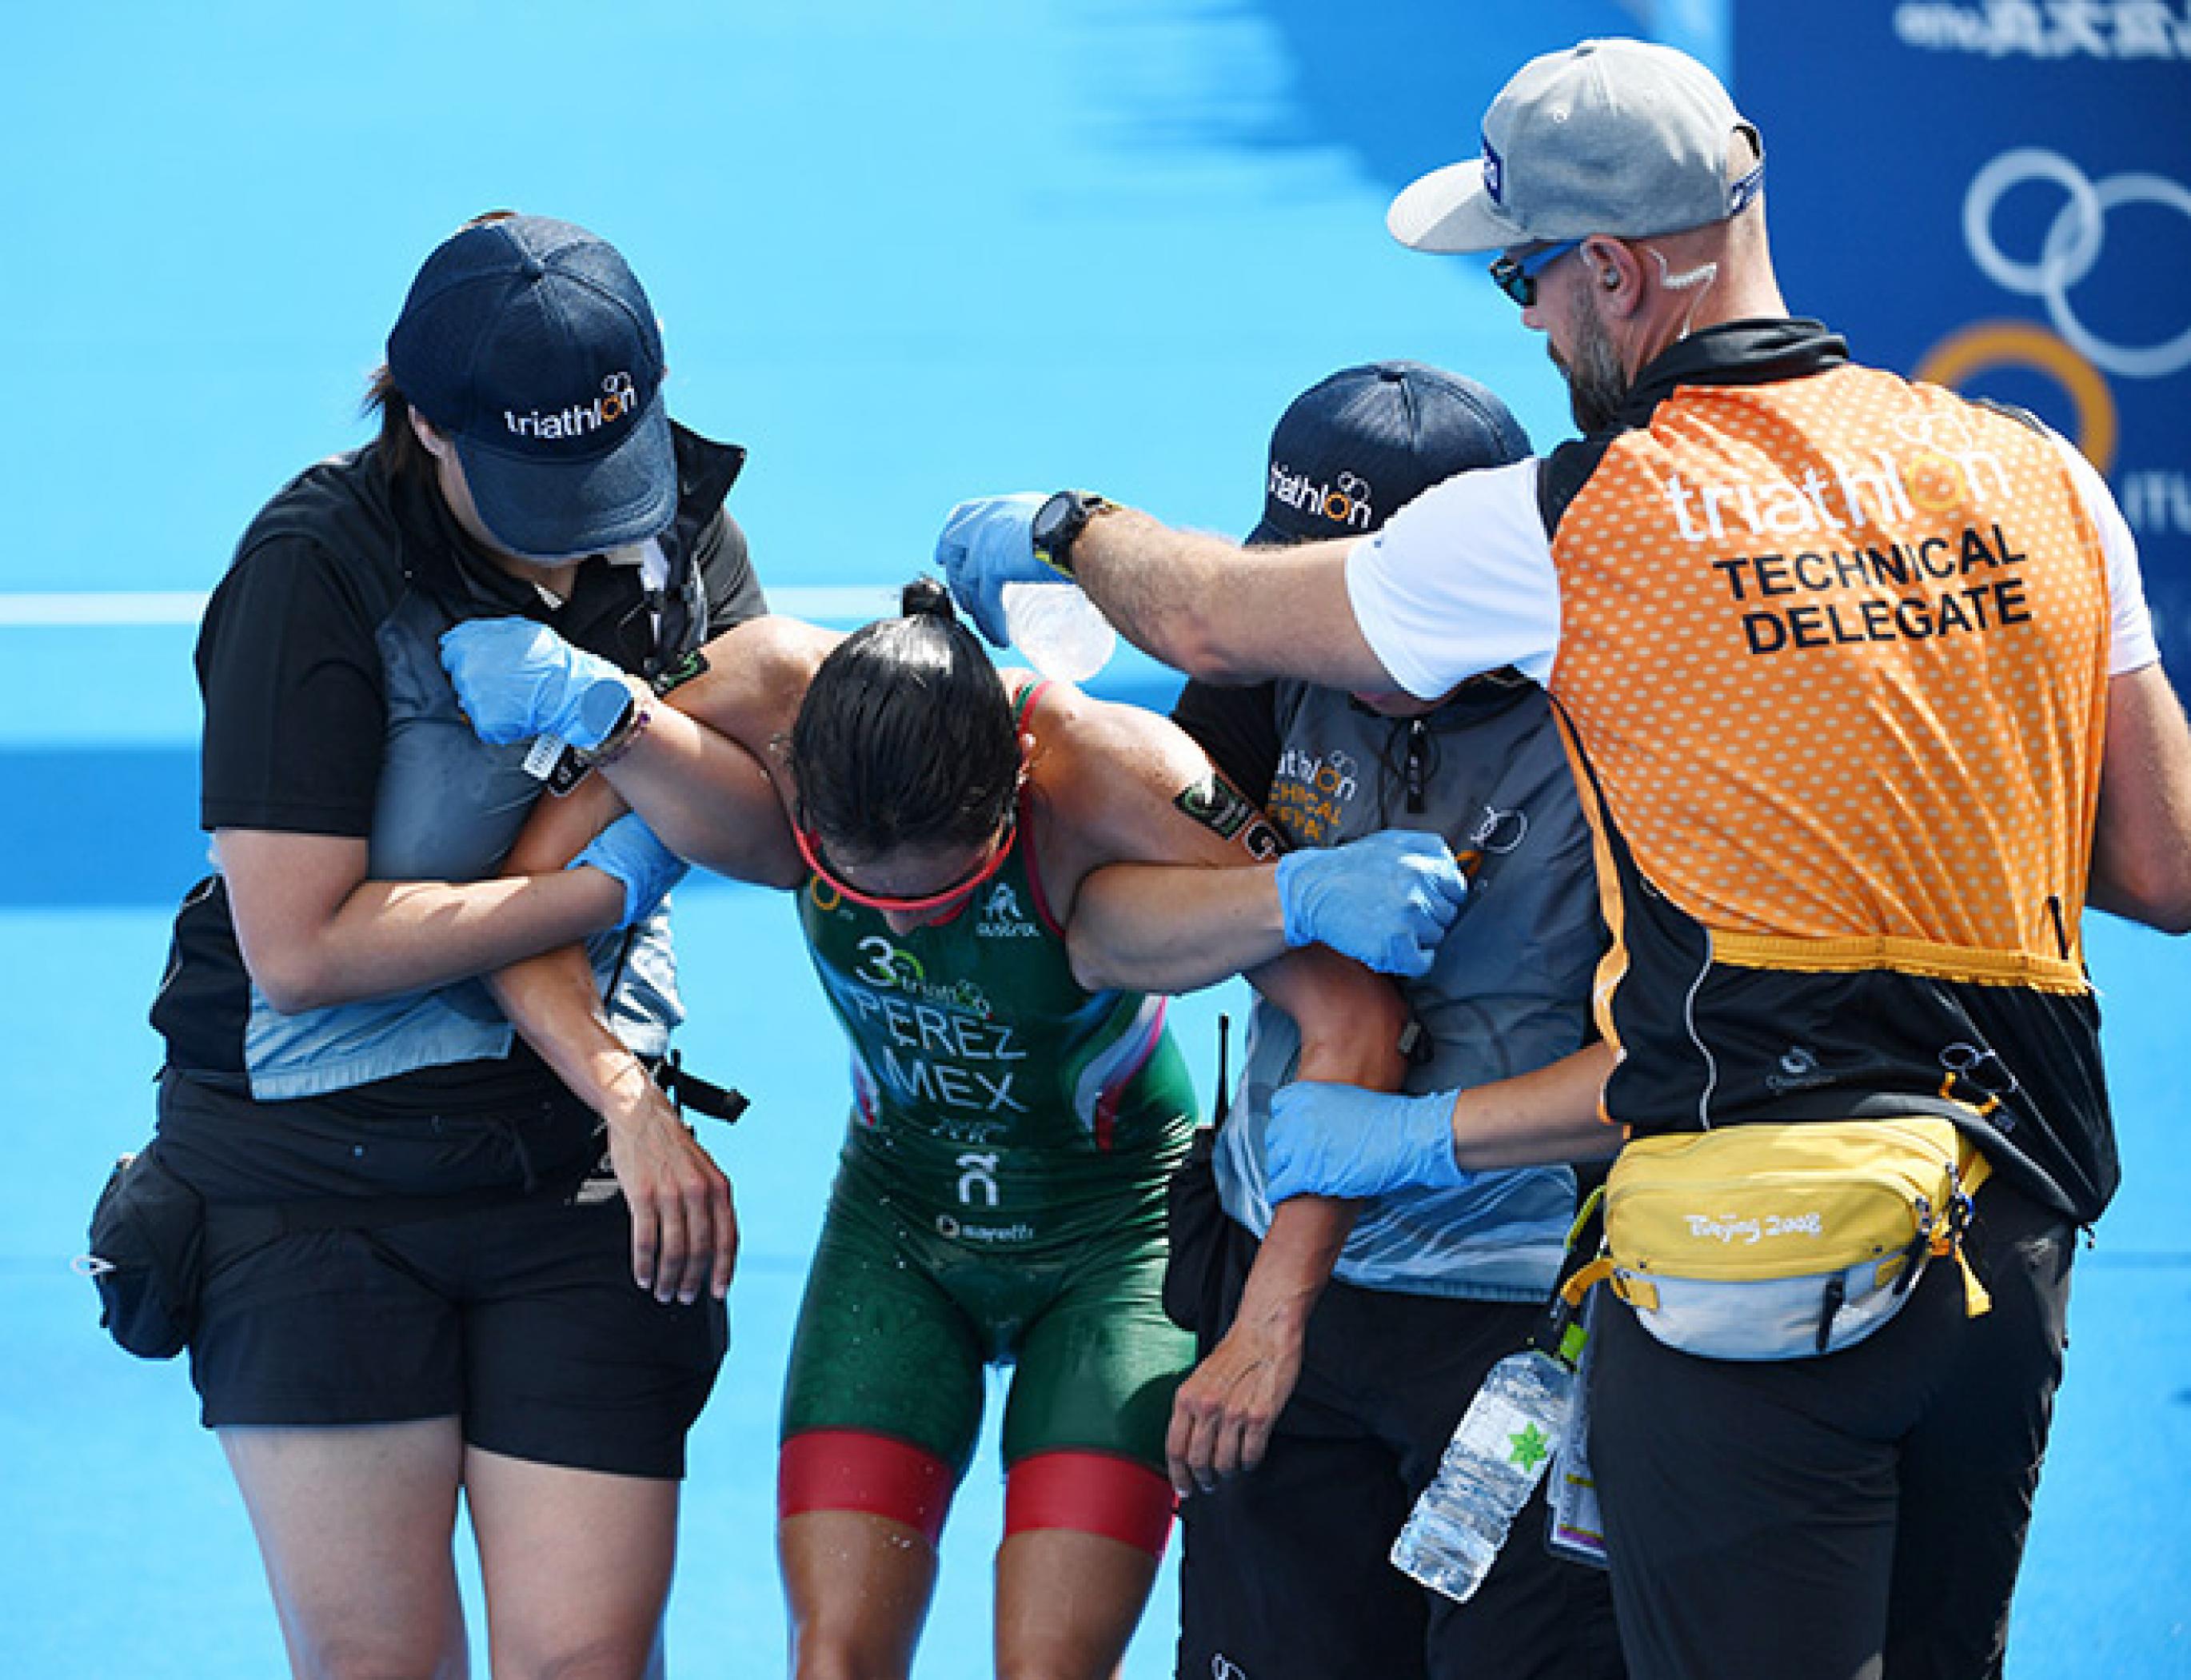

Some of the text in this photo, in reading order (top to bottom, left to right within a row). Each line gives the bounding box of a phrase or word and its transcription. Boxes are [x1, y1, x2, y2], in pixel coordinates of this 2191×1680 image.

[504, 385, 637, 438] triathlon
[1665, 448, 2013, 542] triathlon
[1713, 524, 2028, 601] TECHNICAL
[1742, 577, 2033, 655] DELEGATE
[854, 994, 1029, 1060] PEREZ
[882, 1045, 1030, 1113] MEX
